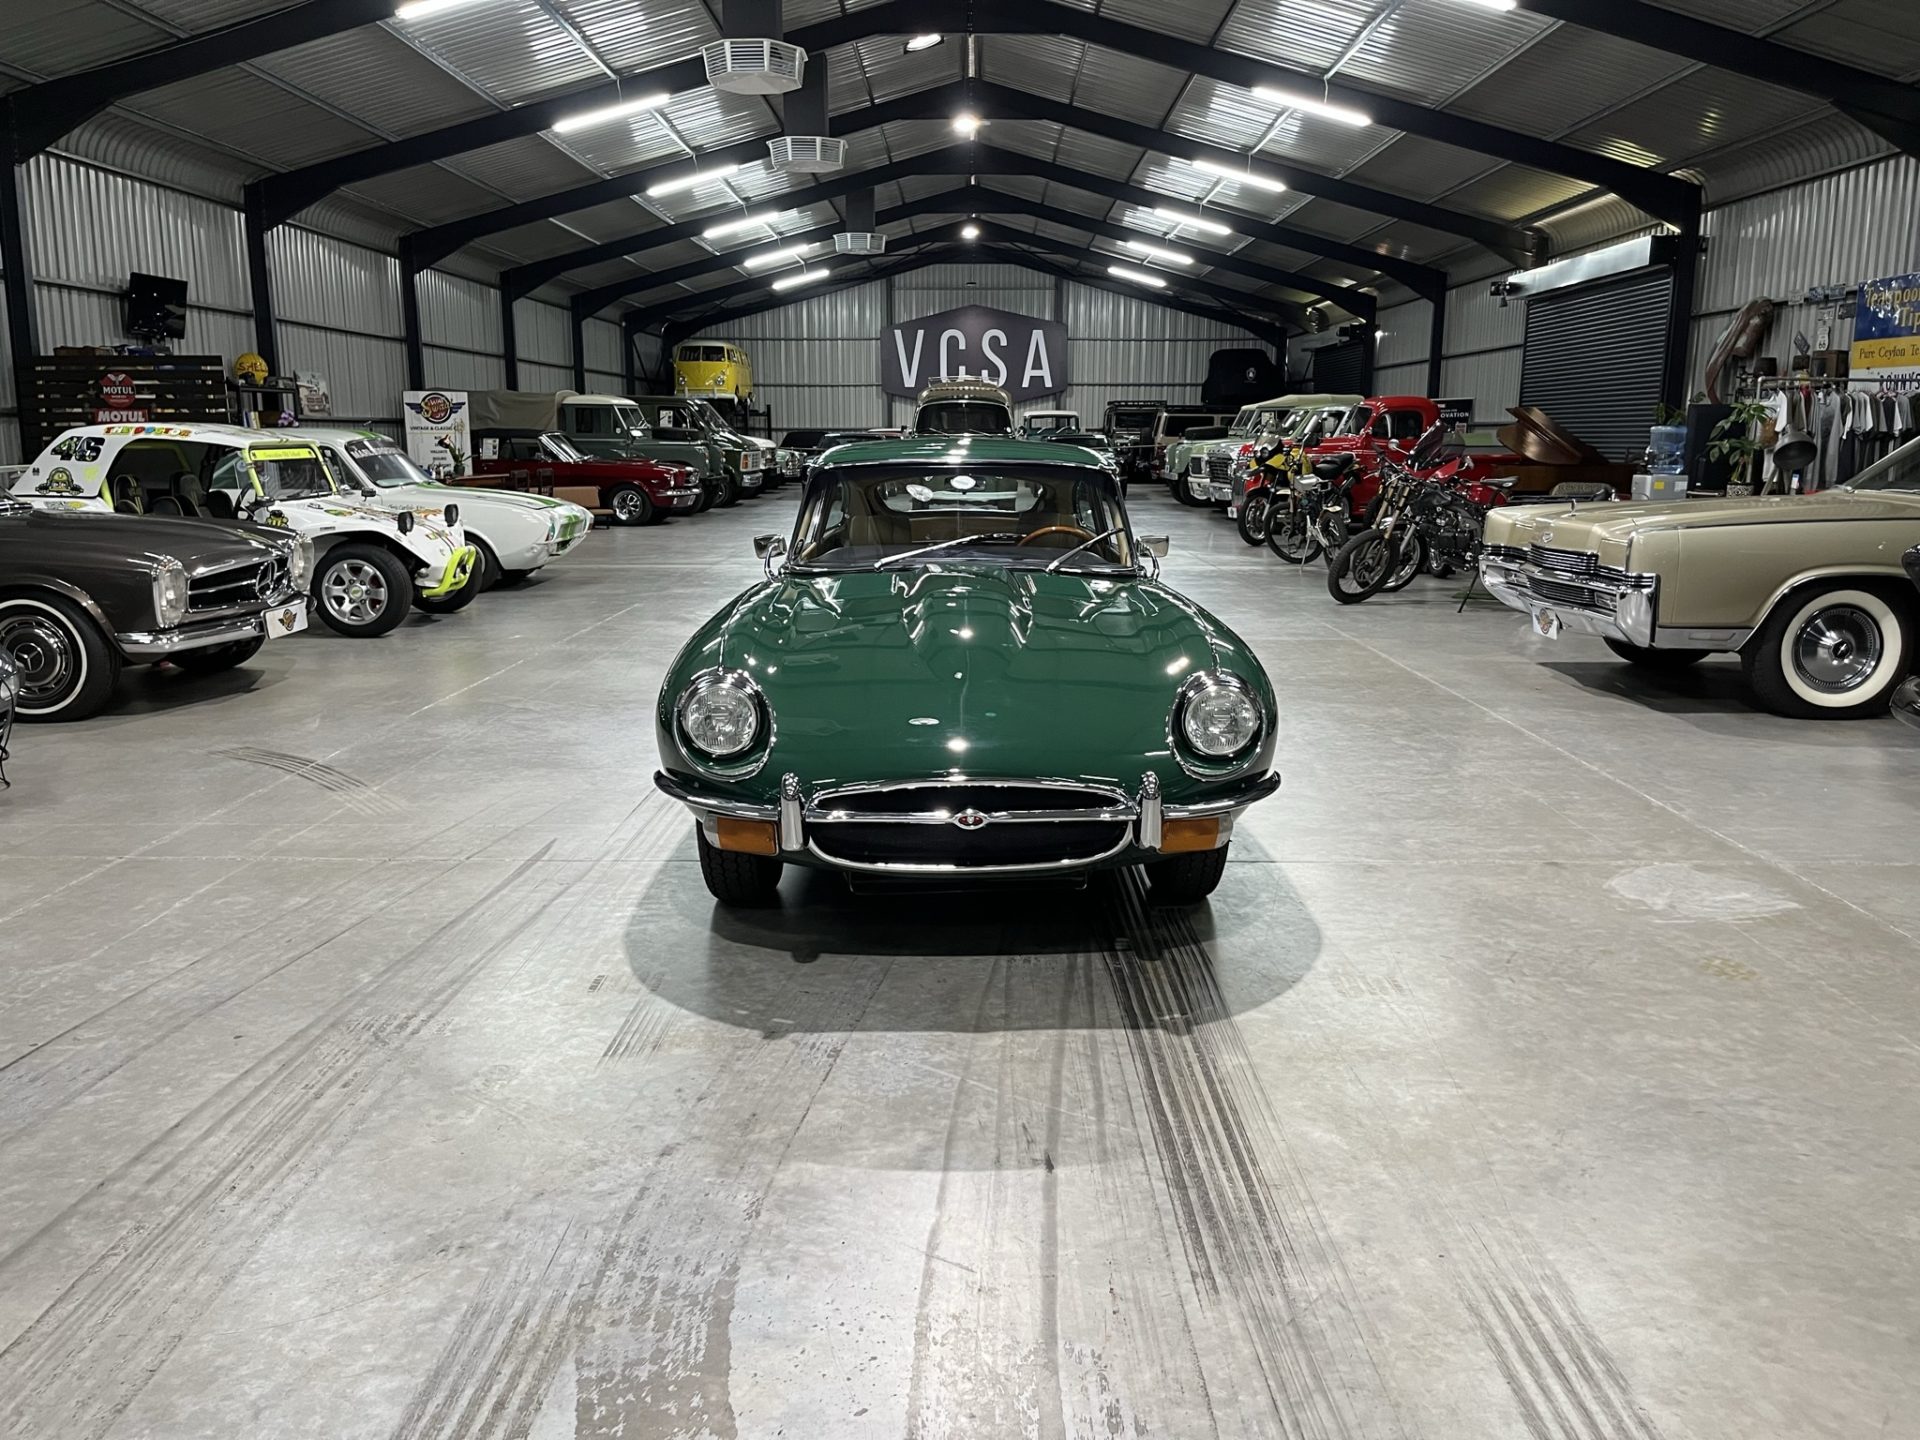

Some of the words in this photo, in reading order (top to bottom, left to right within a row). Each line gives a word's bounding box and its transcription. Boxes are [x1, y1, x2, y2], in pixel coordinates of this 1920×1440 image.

[894, 328, 1053, 388] VCSA
[1860, 348, 1876, 359] Pure
[1879, 345, 1906, 360] Ceylon
[103, 386, 134, 395] MOTUL
[98, 410, 145, 422] MOTUL
[133, 426, 192, 437] DOCTOR
